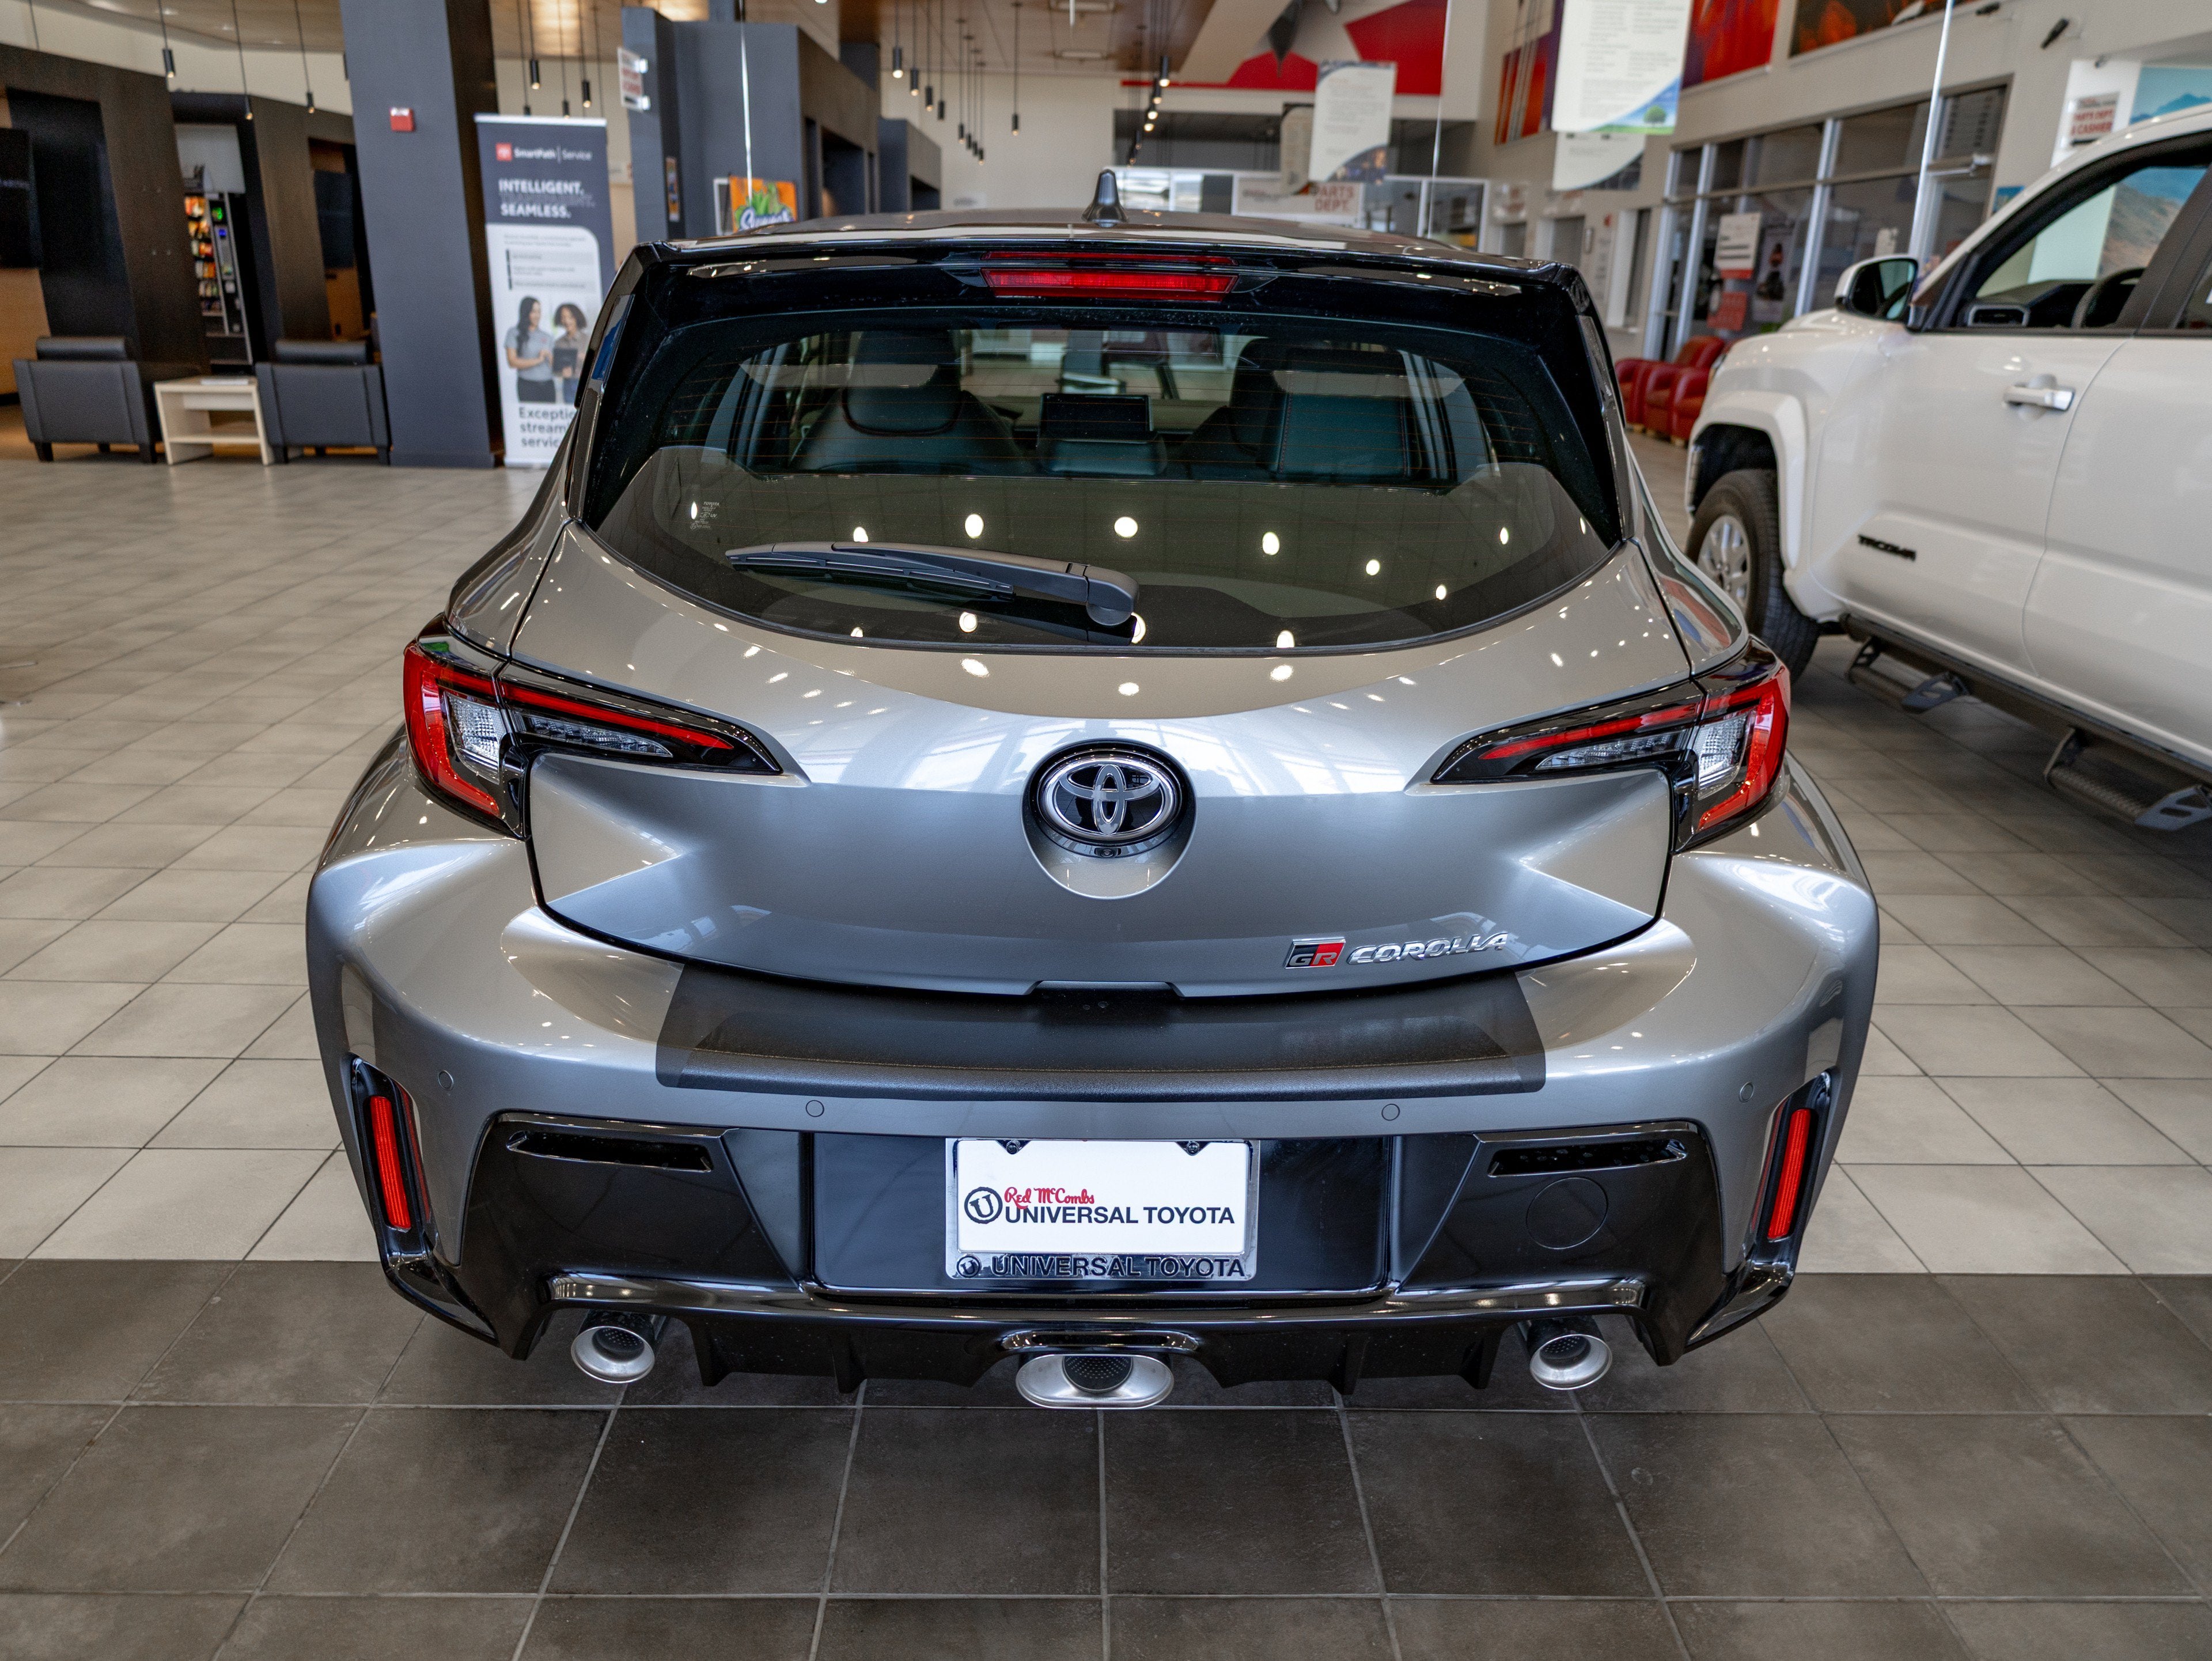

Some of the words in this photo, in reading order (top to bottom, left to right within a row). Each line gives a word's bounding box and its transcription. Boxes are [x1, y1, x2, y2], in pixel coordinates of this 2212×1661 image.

[513, 147, 555, 159] SmartPath
[562, 150, 592, 160] Service
[498, 179, 584, 194] INTELLIGENT.
[501, 203, 571, 218] SEAMLESS.
[520, 422, 569, 432] stream
[1289, 952, 1337, 966] GR
[1346, 931, 1509, 965] COROLLA
[1004, 1186, 1032, 1209] Red
[1033, 1187, 1095, 1204] McCombs
[1005, 1206, 1139, 1224] UNIVERSAL
[1143, 1206, 1235, 1224] TOYOTA
[991, 1255, 1141, 1276] UNIVERSAL
[1144, 1257, 1245, 1277] TOYOTA
